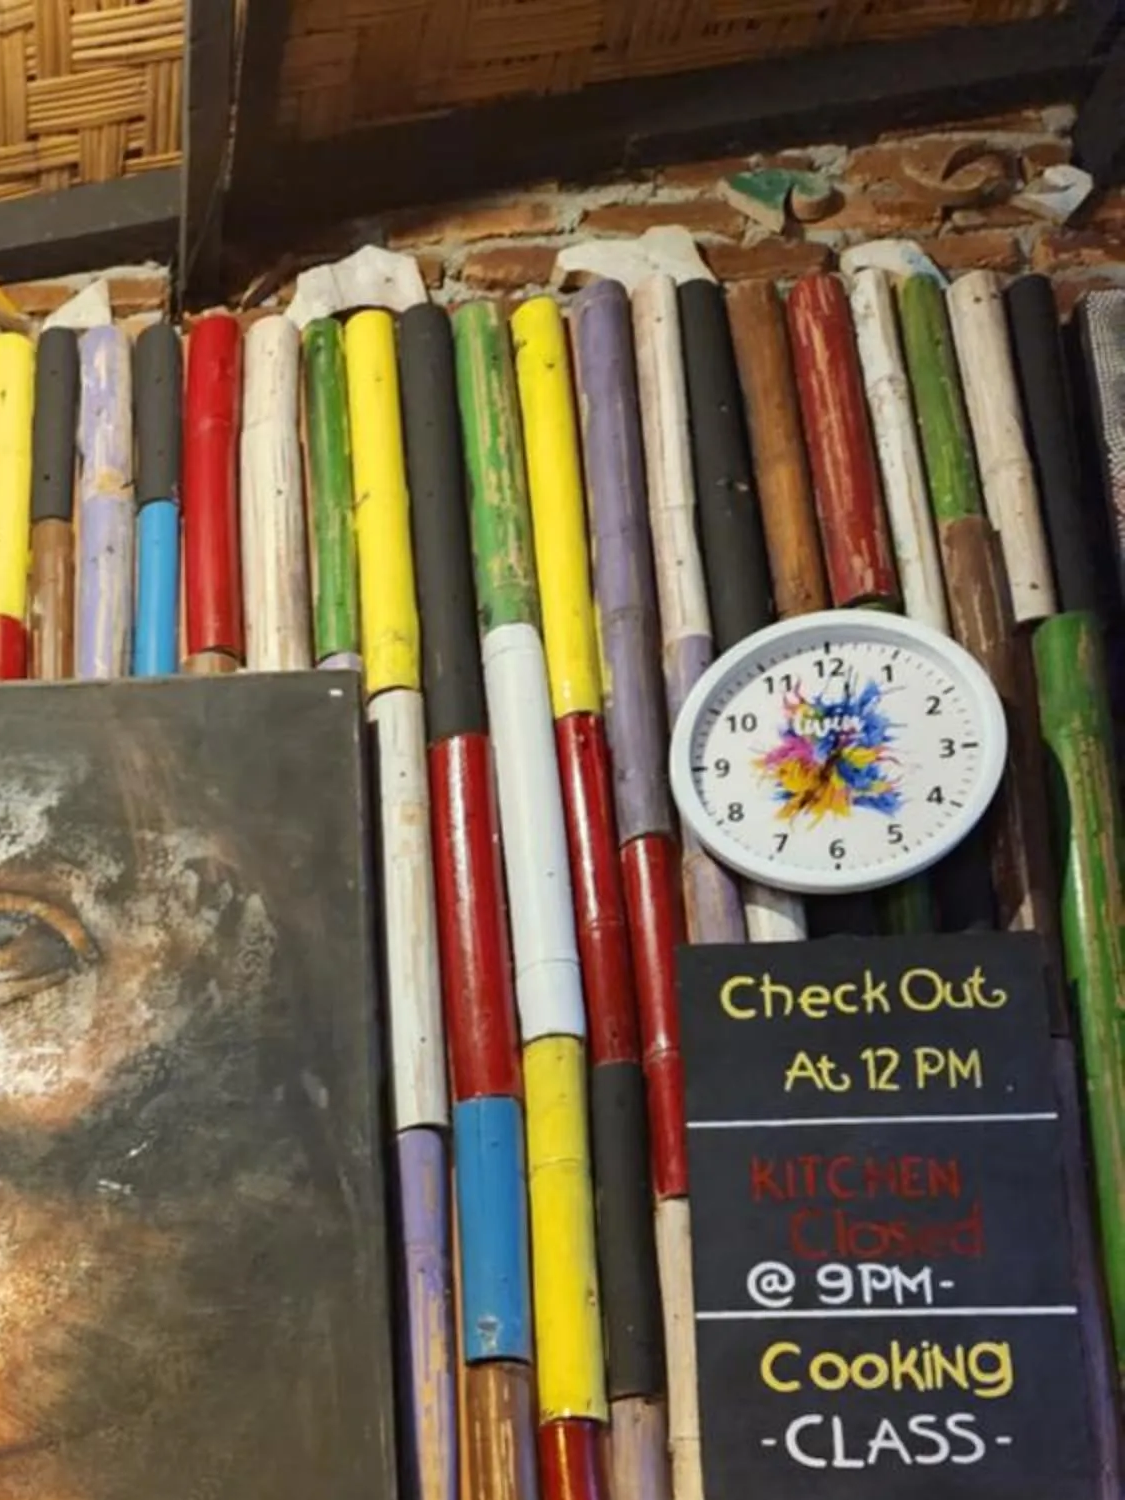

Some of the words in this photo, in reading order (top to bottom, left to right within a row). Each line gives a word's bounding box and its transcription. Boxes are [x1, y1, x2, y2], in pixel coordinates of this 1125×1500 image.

[814, 658, 845, 678] 12
[880, 665, 894, 683] 1
[764, 674, 793, 694] 11
[925, 696, 942, 716] 2
[726, 713, 757, 733] 10
[939, 738, 956, 758] 3
[714, 758, 731, 778] 9
[926, 786, 945, 805] 4
[727, 803, 744, 823] 8
[774, 834, 789, 852] 7
[887, 824, 904, 844] 5
[829, 839, 846, 859] 6
[720, 970, 891, 1019] Check
[900, 966, 1008, 1012] Out
[784, 1050, 852, 1092] At
[860, 1047, 901, 1091] 12
[914, 1047, 983, 1090] PM
[750, 1154, 963, 1202] KITCHEN
[789, 1195, 986, 1259] Closed
[746, 1261, 796, 1308] @
